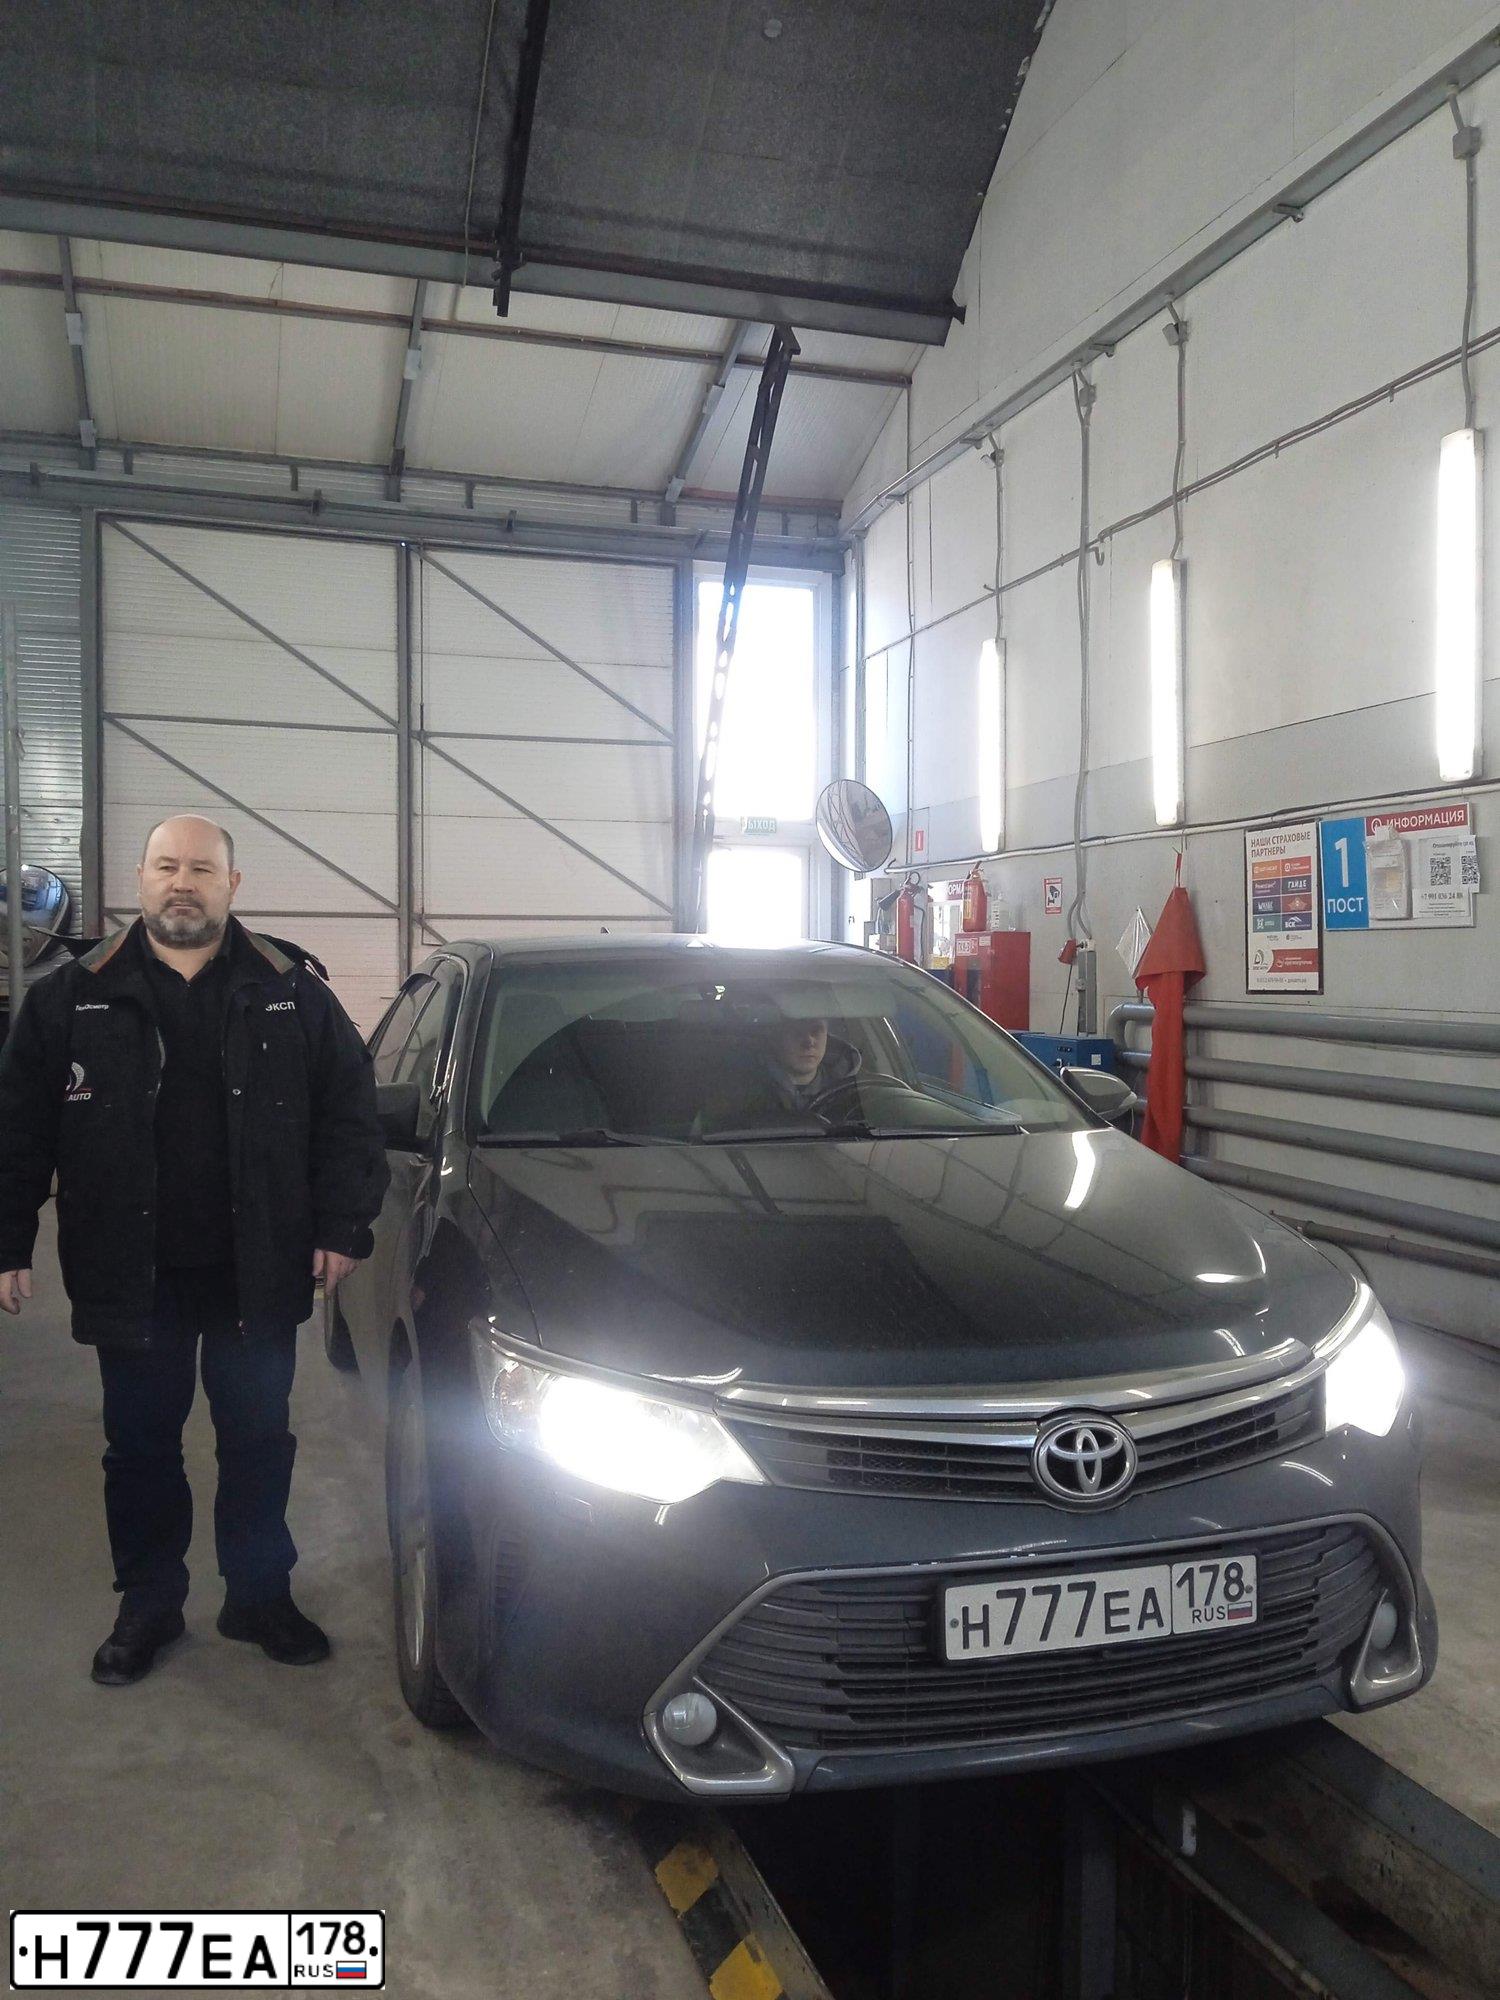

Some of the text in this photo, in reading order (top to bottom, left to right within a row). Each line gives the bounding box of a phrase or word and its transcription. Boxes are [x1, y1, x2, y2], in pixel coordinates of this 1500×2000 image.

[1386, 809, 1464, 829] ИНФОРМАЦИЯ
[1251, 831, 1311, 848] НАШИ СТРАХОВЫЕ
[1251, 846, 1286, 858] ПАРТНЕРЫ
[1334, 837, 1349, 888] 1
[1327, 897, 1364, 914] ПОСТ
[1175, 1561, 1245, 1609] 178
[1191, 1605, 1226, 1624] RUS
